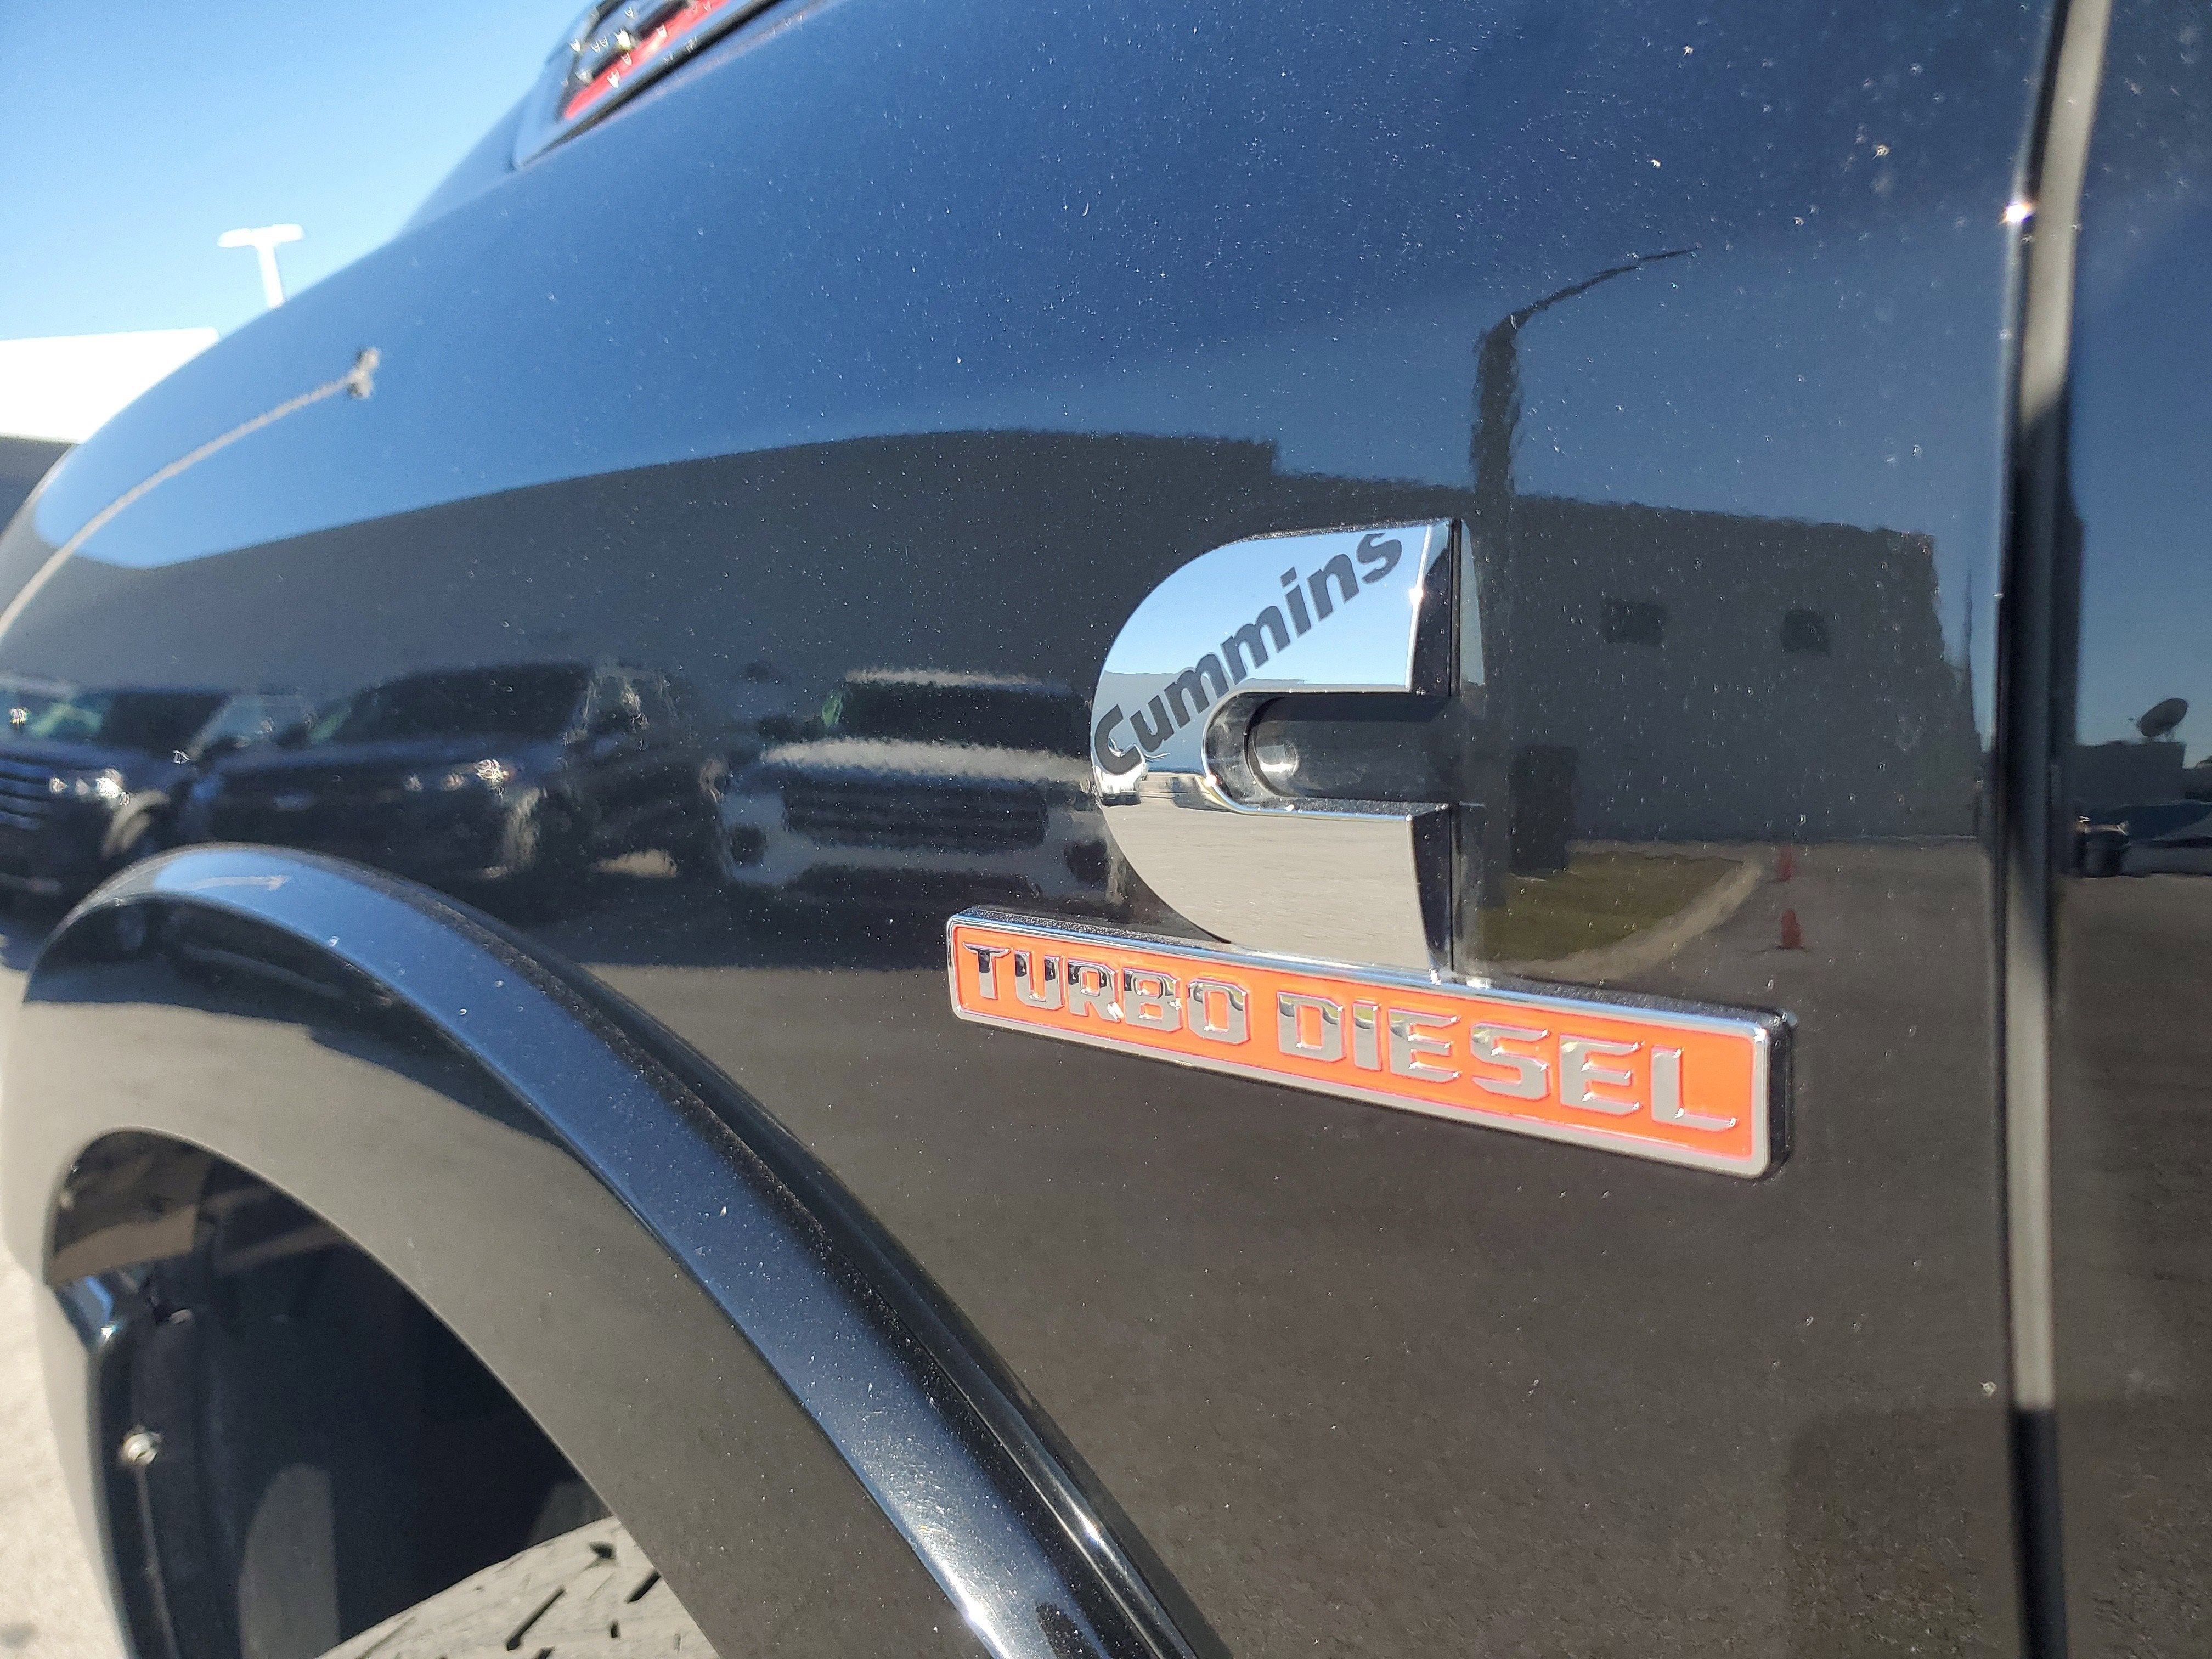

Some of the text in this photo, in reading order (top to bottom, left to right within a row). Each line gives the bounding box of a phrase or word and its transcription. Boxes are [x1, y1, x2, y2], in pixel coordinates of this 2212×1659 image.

[1094, 532, 1403, 775] Cummins
[962, 940, 1739, 1132] TURBO DIESEL
